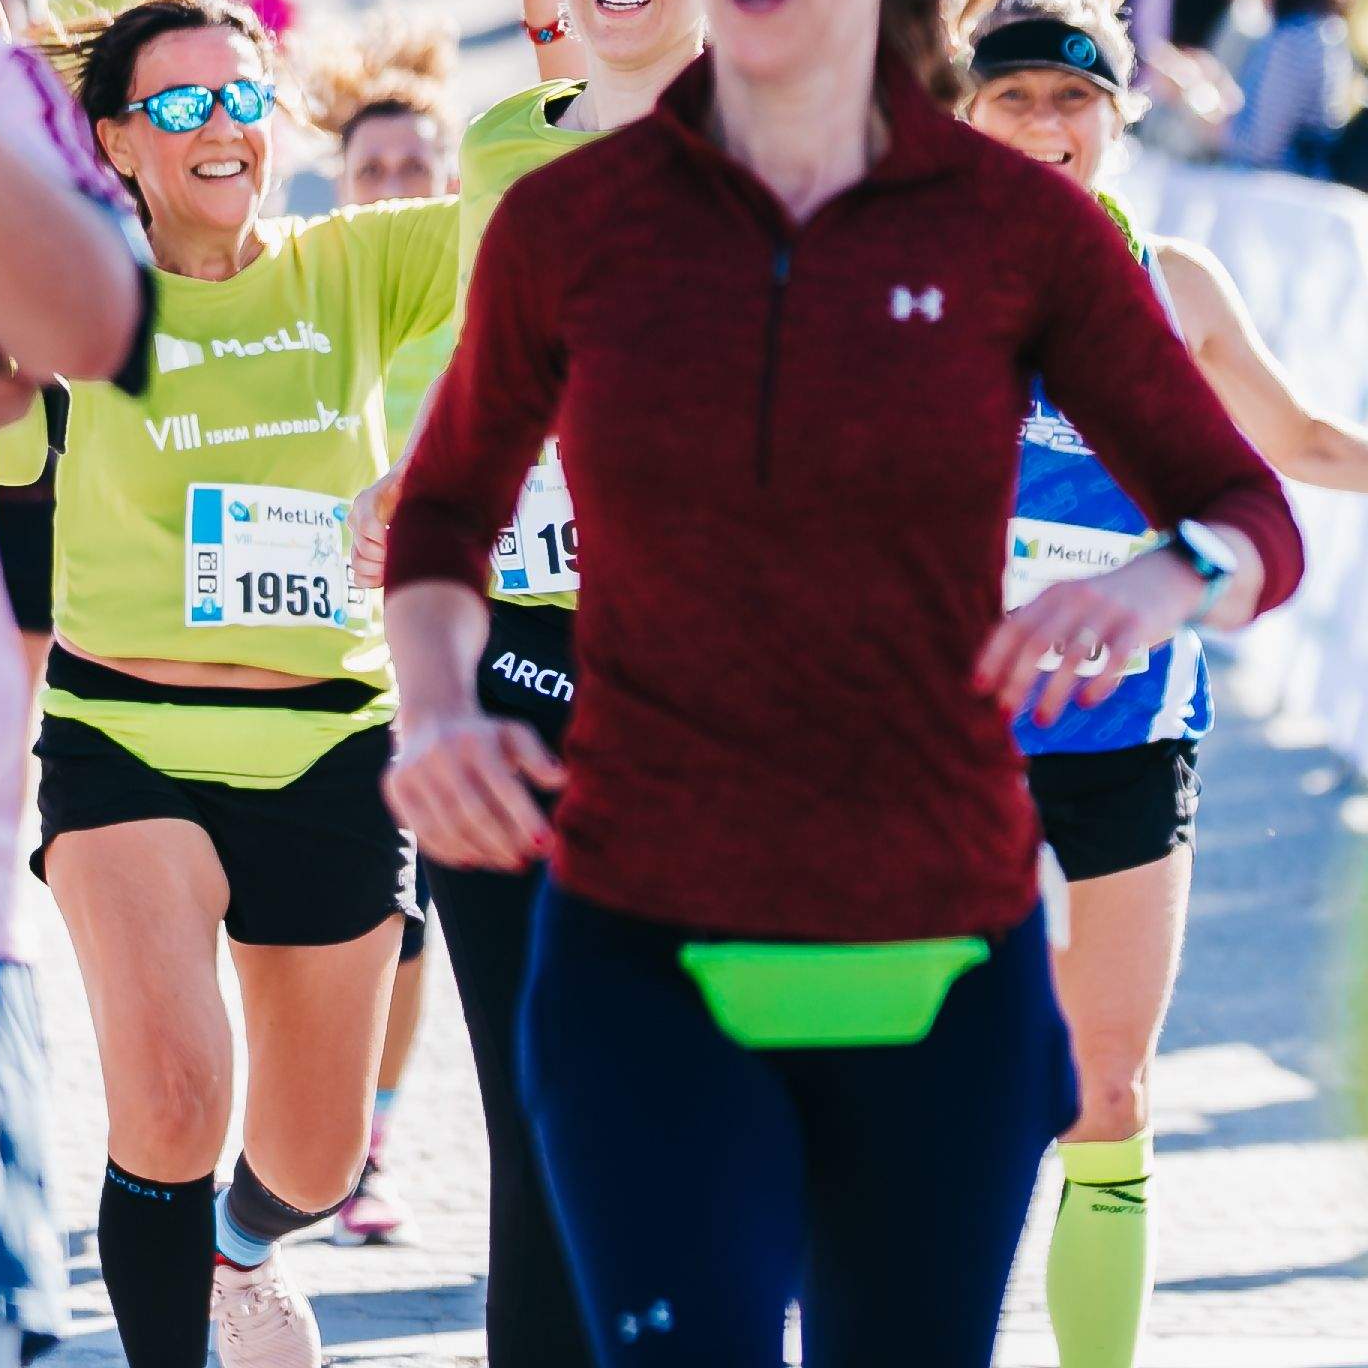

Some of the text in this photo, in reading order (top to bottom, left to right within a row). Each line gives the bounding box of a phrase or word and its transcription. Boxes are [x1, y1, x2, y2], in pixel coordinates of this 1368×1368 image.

[209, 320, 332, 359] MetLife
[143, 412, 202, 453] VIII
[205, 425, 250, 447] 15KM
[254, 418, 322, 439] MADRID
[266, 505, 334, 529] MetLife
[1046, 542, 1121, 569] MetLife
[235, 571, 332, 619] 1953
